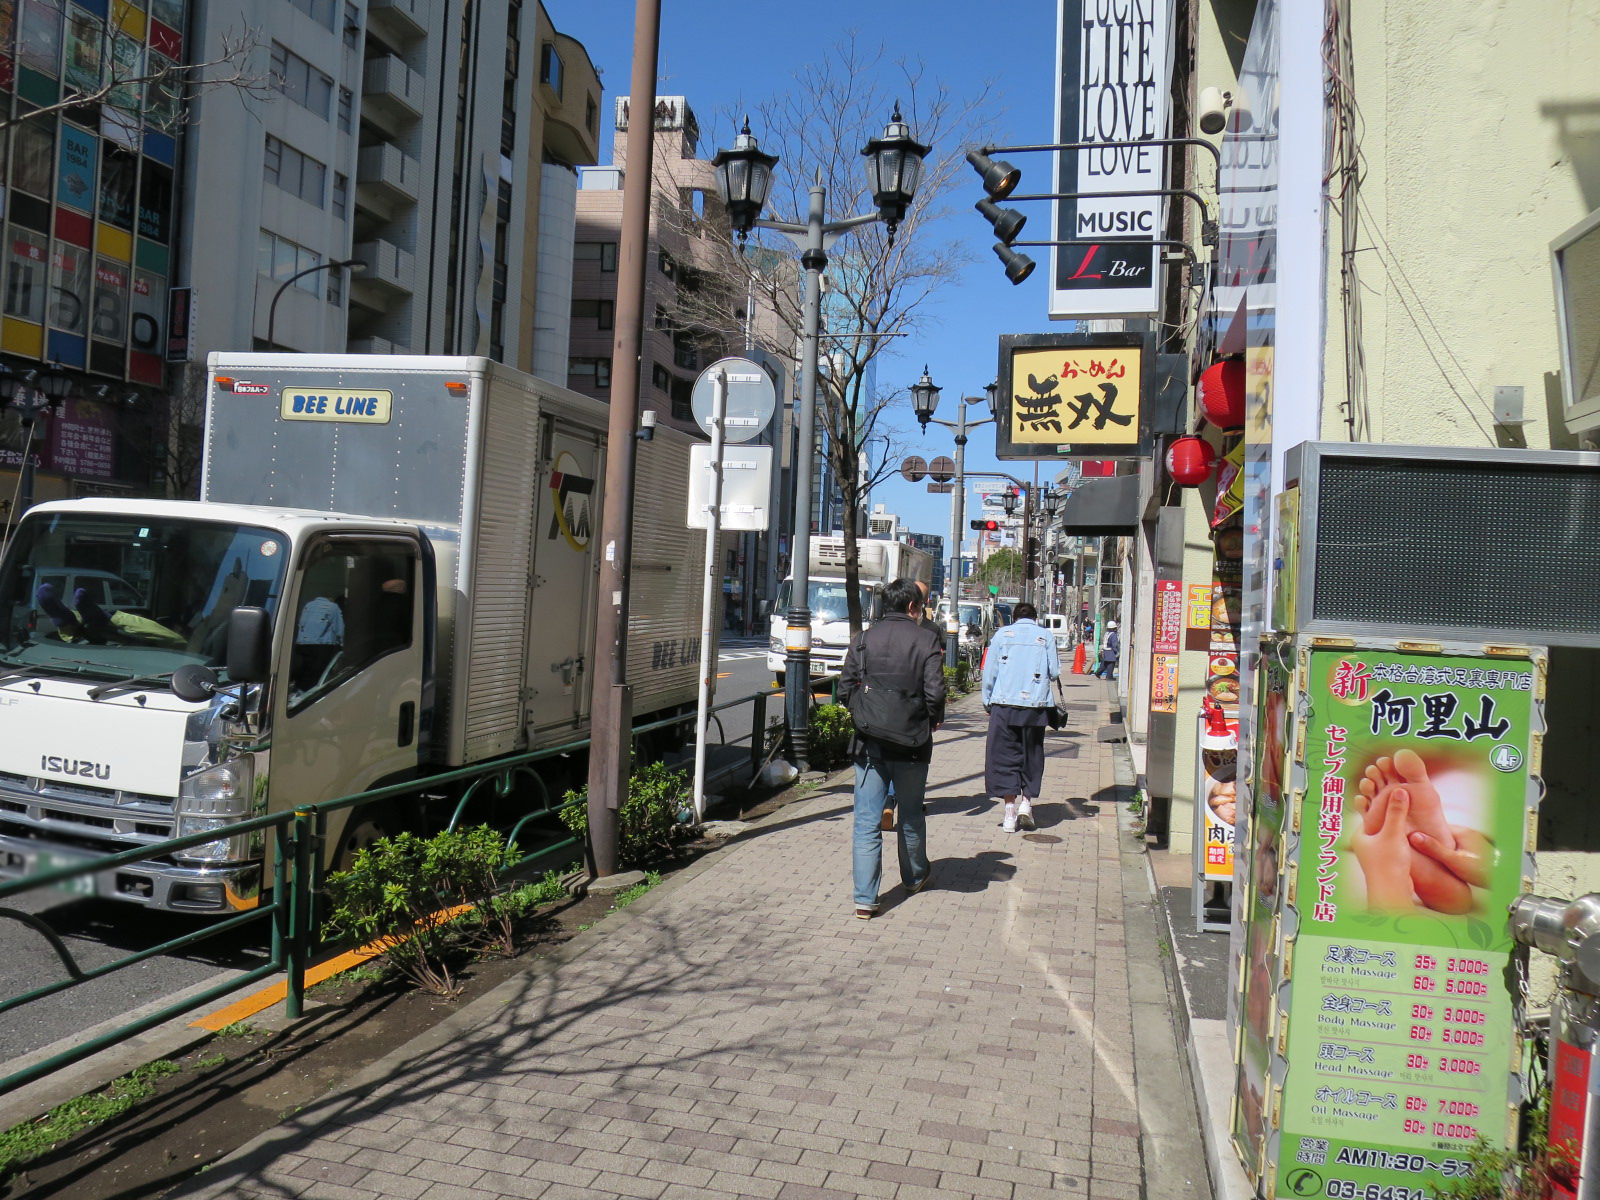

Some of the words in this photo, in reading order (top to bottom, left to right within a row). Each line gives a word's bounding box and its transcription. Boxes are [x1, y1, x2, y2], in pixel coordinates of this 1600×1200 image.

[1082, 21, 1155, 88] LIFE
[1082, 84, 1155, 141] LOVE
[67, 139, 88, 157] BAR
[1087, 139, 1151, 176] LOVE
[66, 152, 88, 168] 1984
[1077, 210, 1153, 234] MUSIC
[292, 395, 328, 414] BEE
[334, 396, 379, 416] LINE
[652, 640, 677, 671] BEE
[681, 638, 701, 666] LIN
[1154, 667, 1165, 707] 2980円
[1331, 660, 1373, 700] 新
[1372, 663, 1533, 691] 本格台湾式足裏専門店
[1370, 688, 1511, 742] 阿里山
[41, 754, 110, 780] ISUZU
[1496, 747, 1518, 768] 4F
[1312, 724, 1348, 923] セレブ御用達ブランド店
[1324, 945, 1397, 967] 足裏コース
[1321, 963, 1345, 974] Foot
[1351, 966, 1397, 979] Massage
[1320, 993, 1393, 1016] 全身コース
[1317, 1014, 1345, 1026] Body
[1350, 1017, 1397, 1031] Massage
[1318, 1042, 1376, 1064] 頭コース
[1314, 1061, 1342, 1073] Head
[1348, 1064, 1394, 1079] Massage
[1315, 1085, 1398, 1110] オイルコース
[1311, 1104, 1327, 1115] Oil
[1332, 1106, 1379, 1122] Massage
[1299, 1137, 1330, 1151] 営業
[1296, 1151, 1327, 1165] 時間
